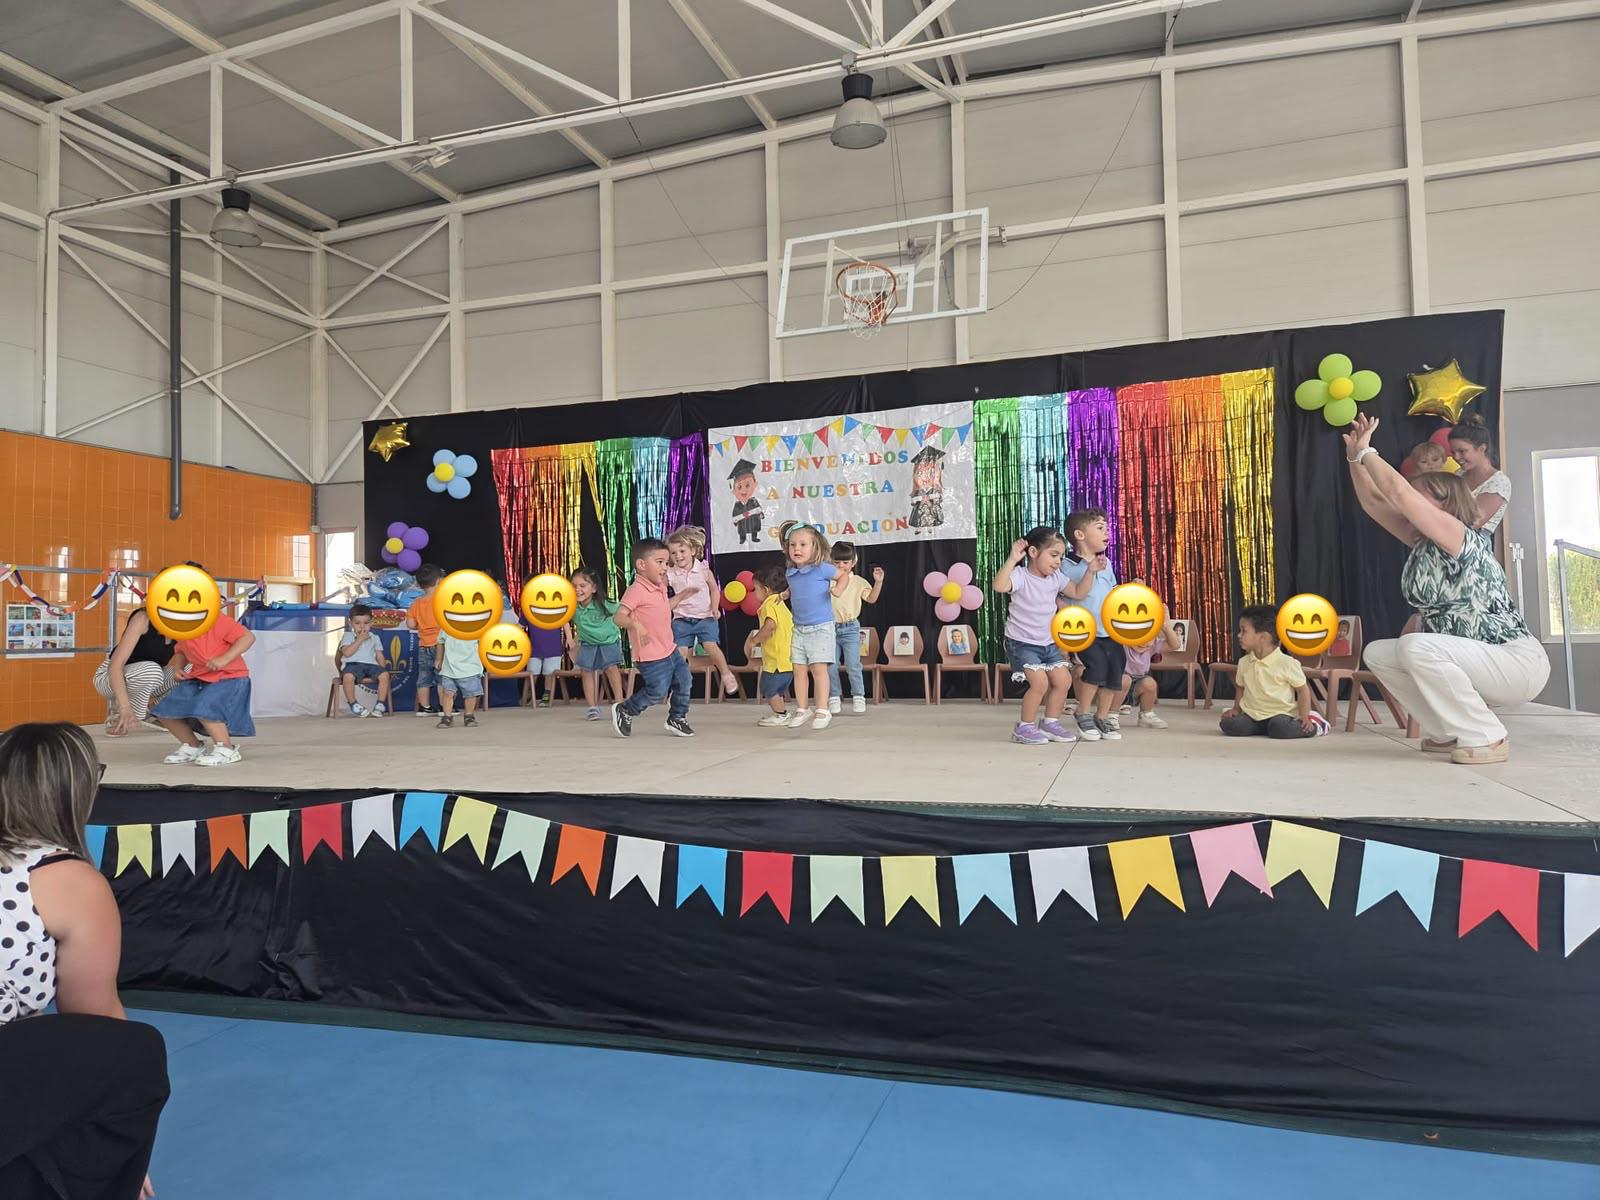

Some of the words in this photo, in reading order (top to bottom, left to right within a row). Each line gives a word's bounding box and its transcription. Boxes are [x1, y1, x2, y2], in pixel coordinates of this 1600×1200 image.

[767, 486, 779, 500] A
[792, 480, 894, 499] NUESTRA
[768, 513, 909, 538] GDUACIÓN
